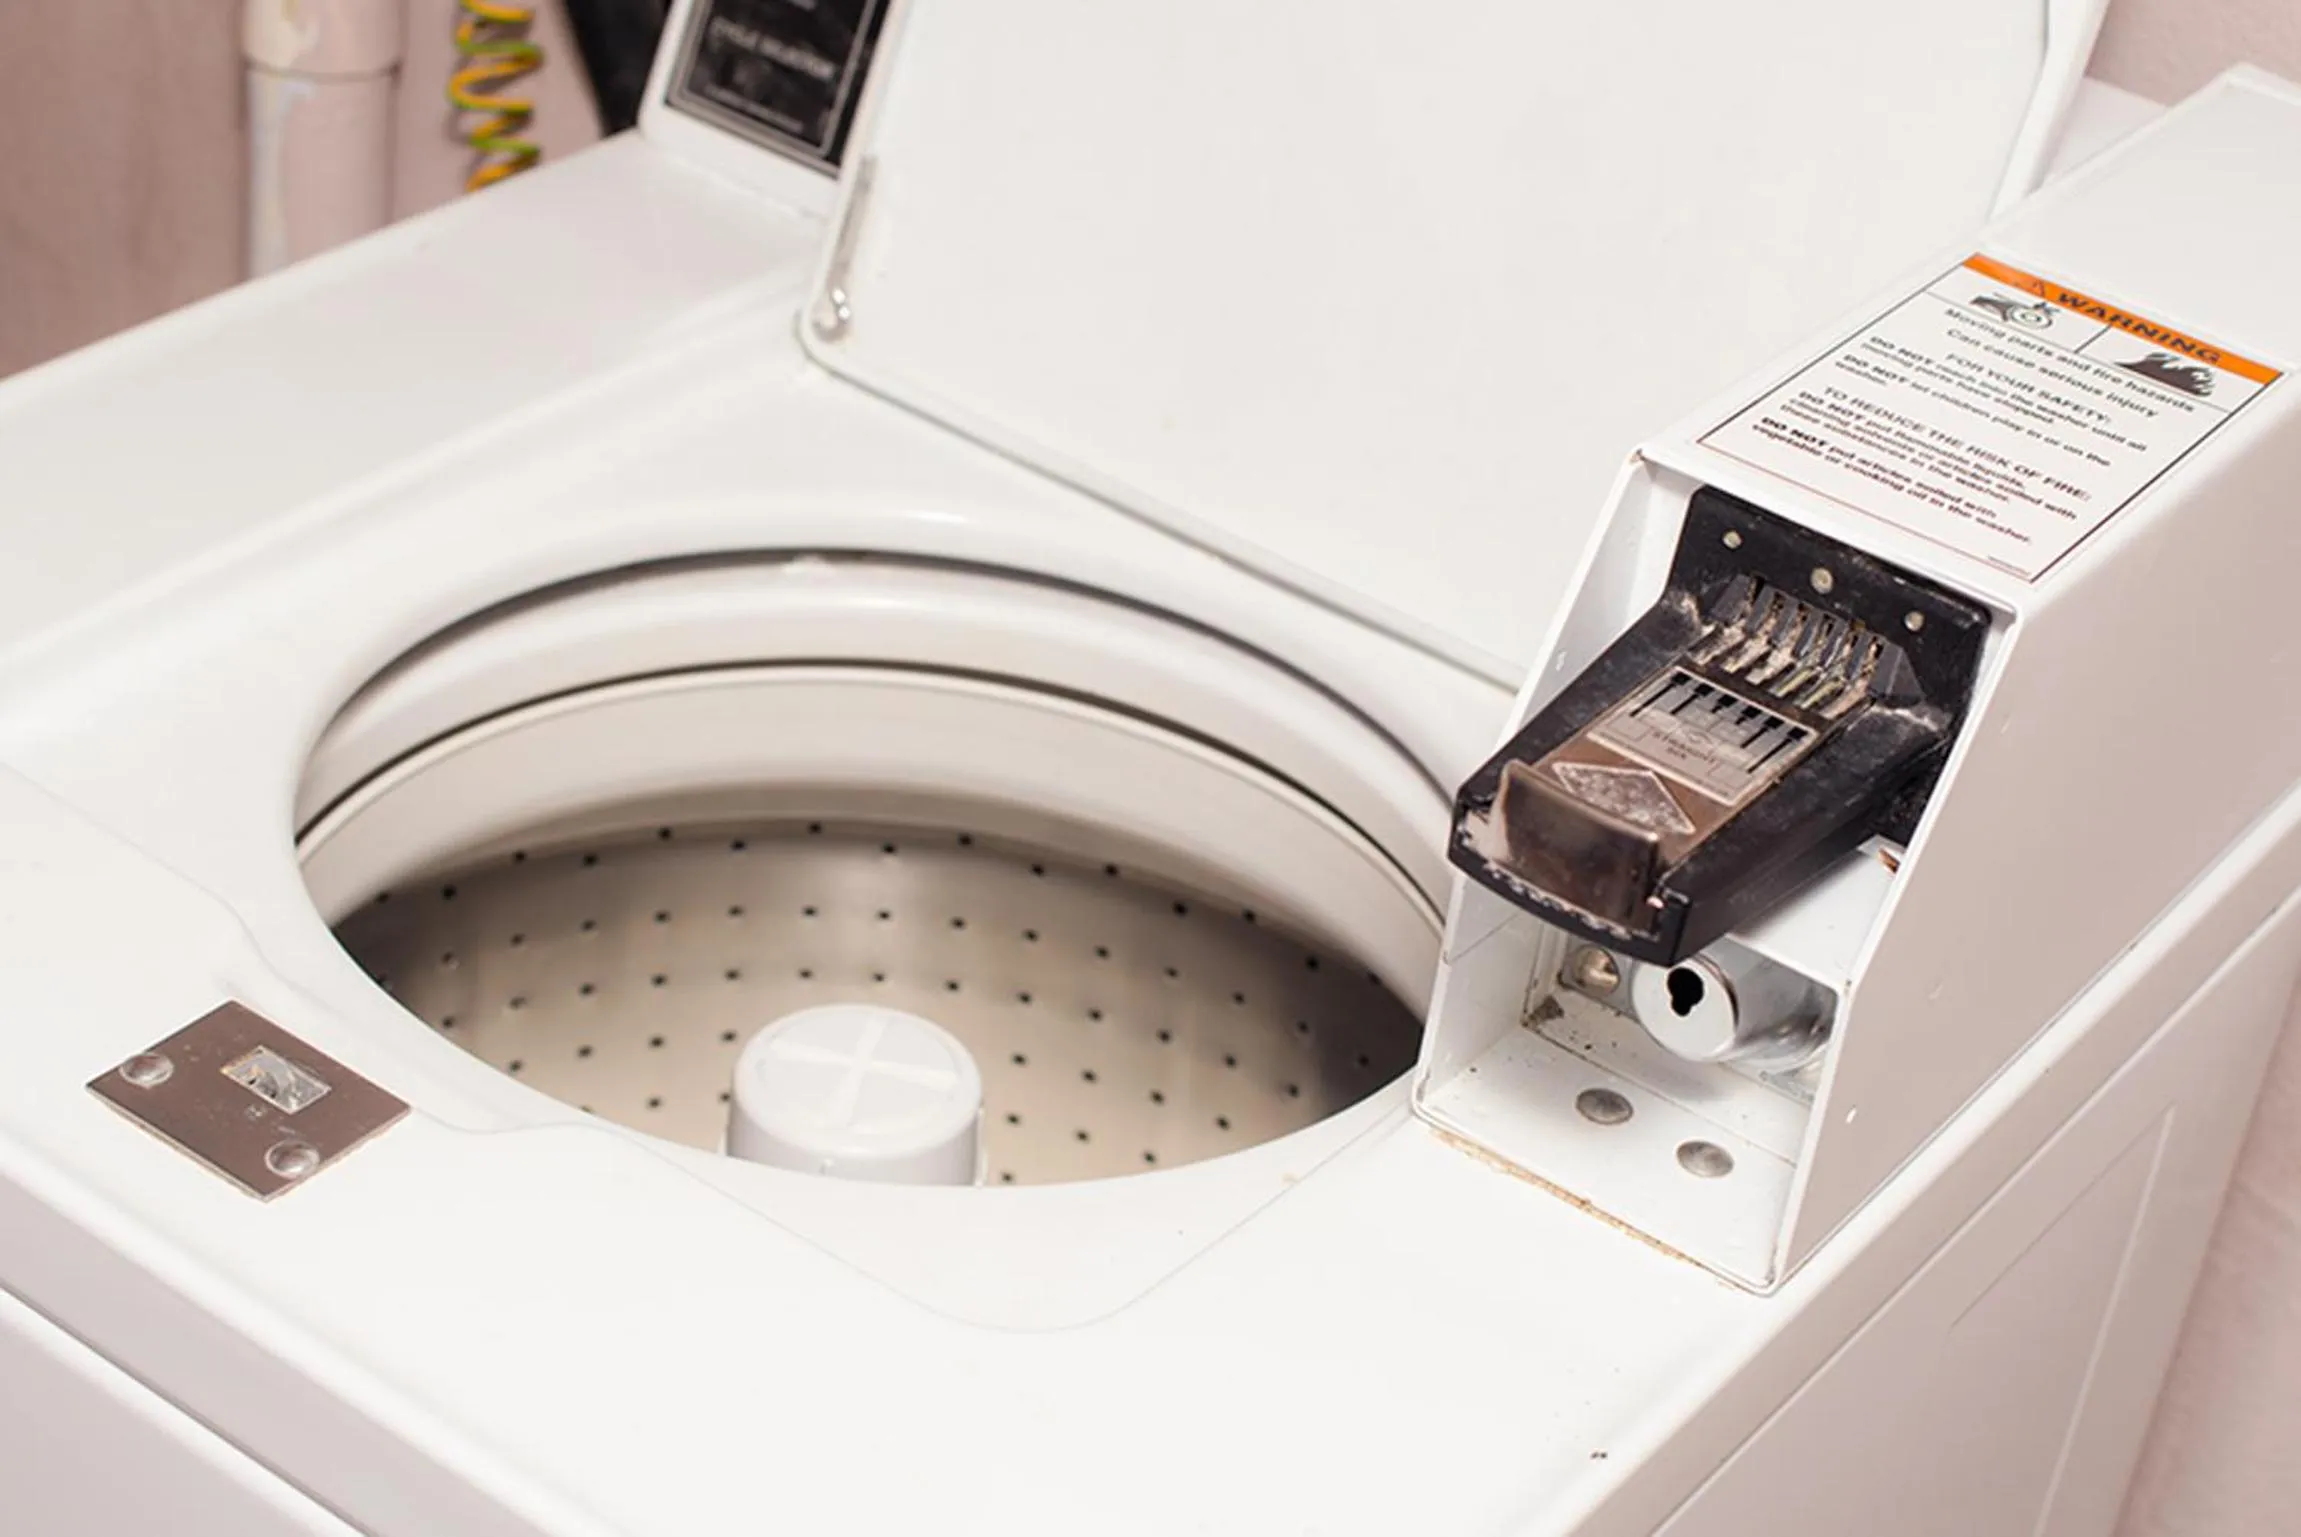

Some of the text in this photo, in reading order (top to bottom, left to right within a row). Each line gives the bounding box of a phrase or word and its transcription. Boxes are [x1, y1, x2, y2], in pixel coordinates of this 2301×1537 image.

[1860, 342, 1914, 368] moving
[1914, 365, 1953, 383] parts
[1955, 380, 1991, 398] have
[1944, 307, 2195, 412] Moving parts and fire hazards
[1945, 352, 1984, 372] FOR
[1987, 368, 2035, 393] YOUR
[1946, 328, 2158, 417] Can cause serious injury
[2059, 293, 2218, 364] WARNING
[1798, 390, 1824, 405] DO
[1826, 402, 1866, 421] NOT
[1864, 419, 1892, 433] put
[1823, 386, 1848, 400] TO
[1849, 397, 1925, 432] REDUCE
[1928, 429, 1964, 448] THE
[1965, 444, 2011, 468] RISK
[2013, 464, 2042, 478] OF
[1842, 353, 2111, 466] DO NOT let children play in or on the
[1869, 335, 1895, 349] DO
[1897, 347, 1934, 365] NOT
[2009, 393, 2034, 407] the
[2036, 404, 2089, 428] washer
[2126, 440, 2147, 452] all
[1751, 423, 1823, 456] vegetable
[1823, 454, 1842, 464] or
[1843, 462, 1905, 491] cooking
[1905, 488, 1928, 500] oil
[1928, 497, 1945, 508] in
[1947, 504, 1972, 518] the
[1760, 416, 1996, 518] DO NOT put articles soiled with
[1779, 403, 1820, 424] these
[1909, 457, 1925, 467] in
[1927, 464, 1952, 478] the
[1917, 451, 1935, 460] or
[1936, 459, 1992, 485] articles
[1995, 483, 2043, 505] soiled
[2043, 502, 2077, 520] with
